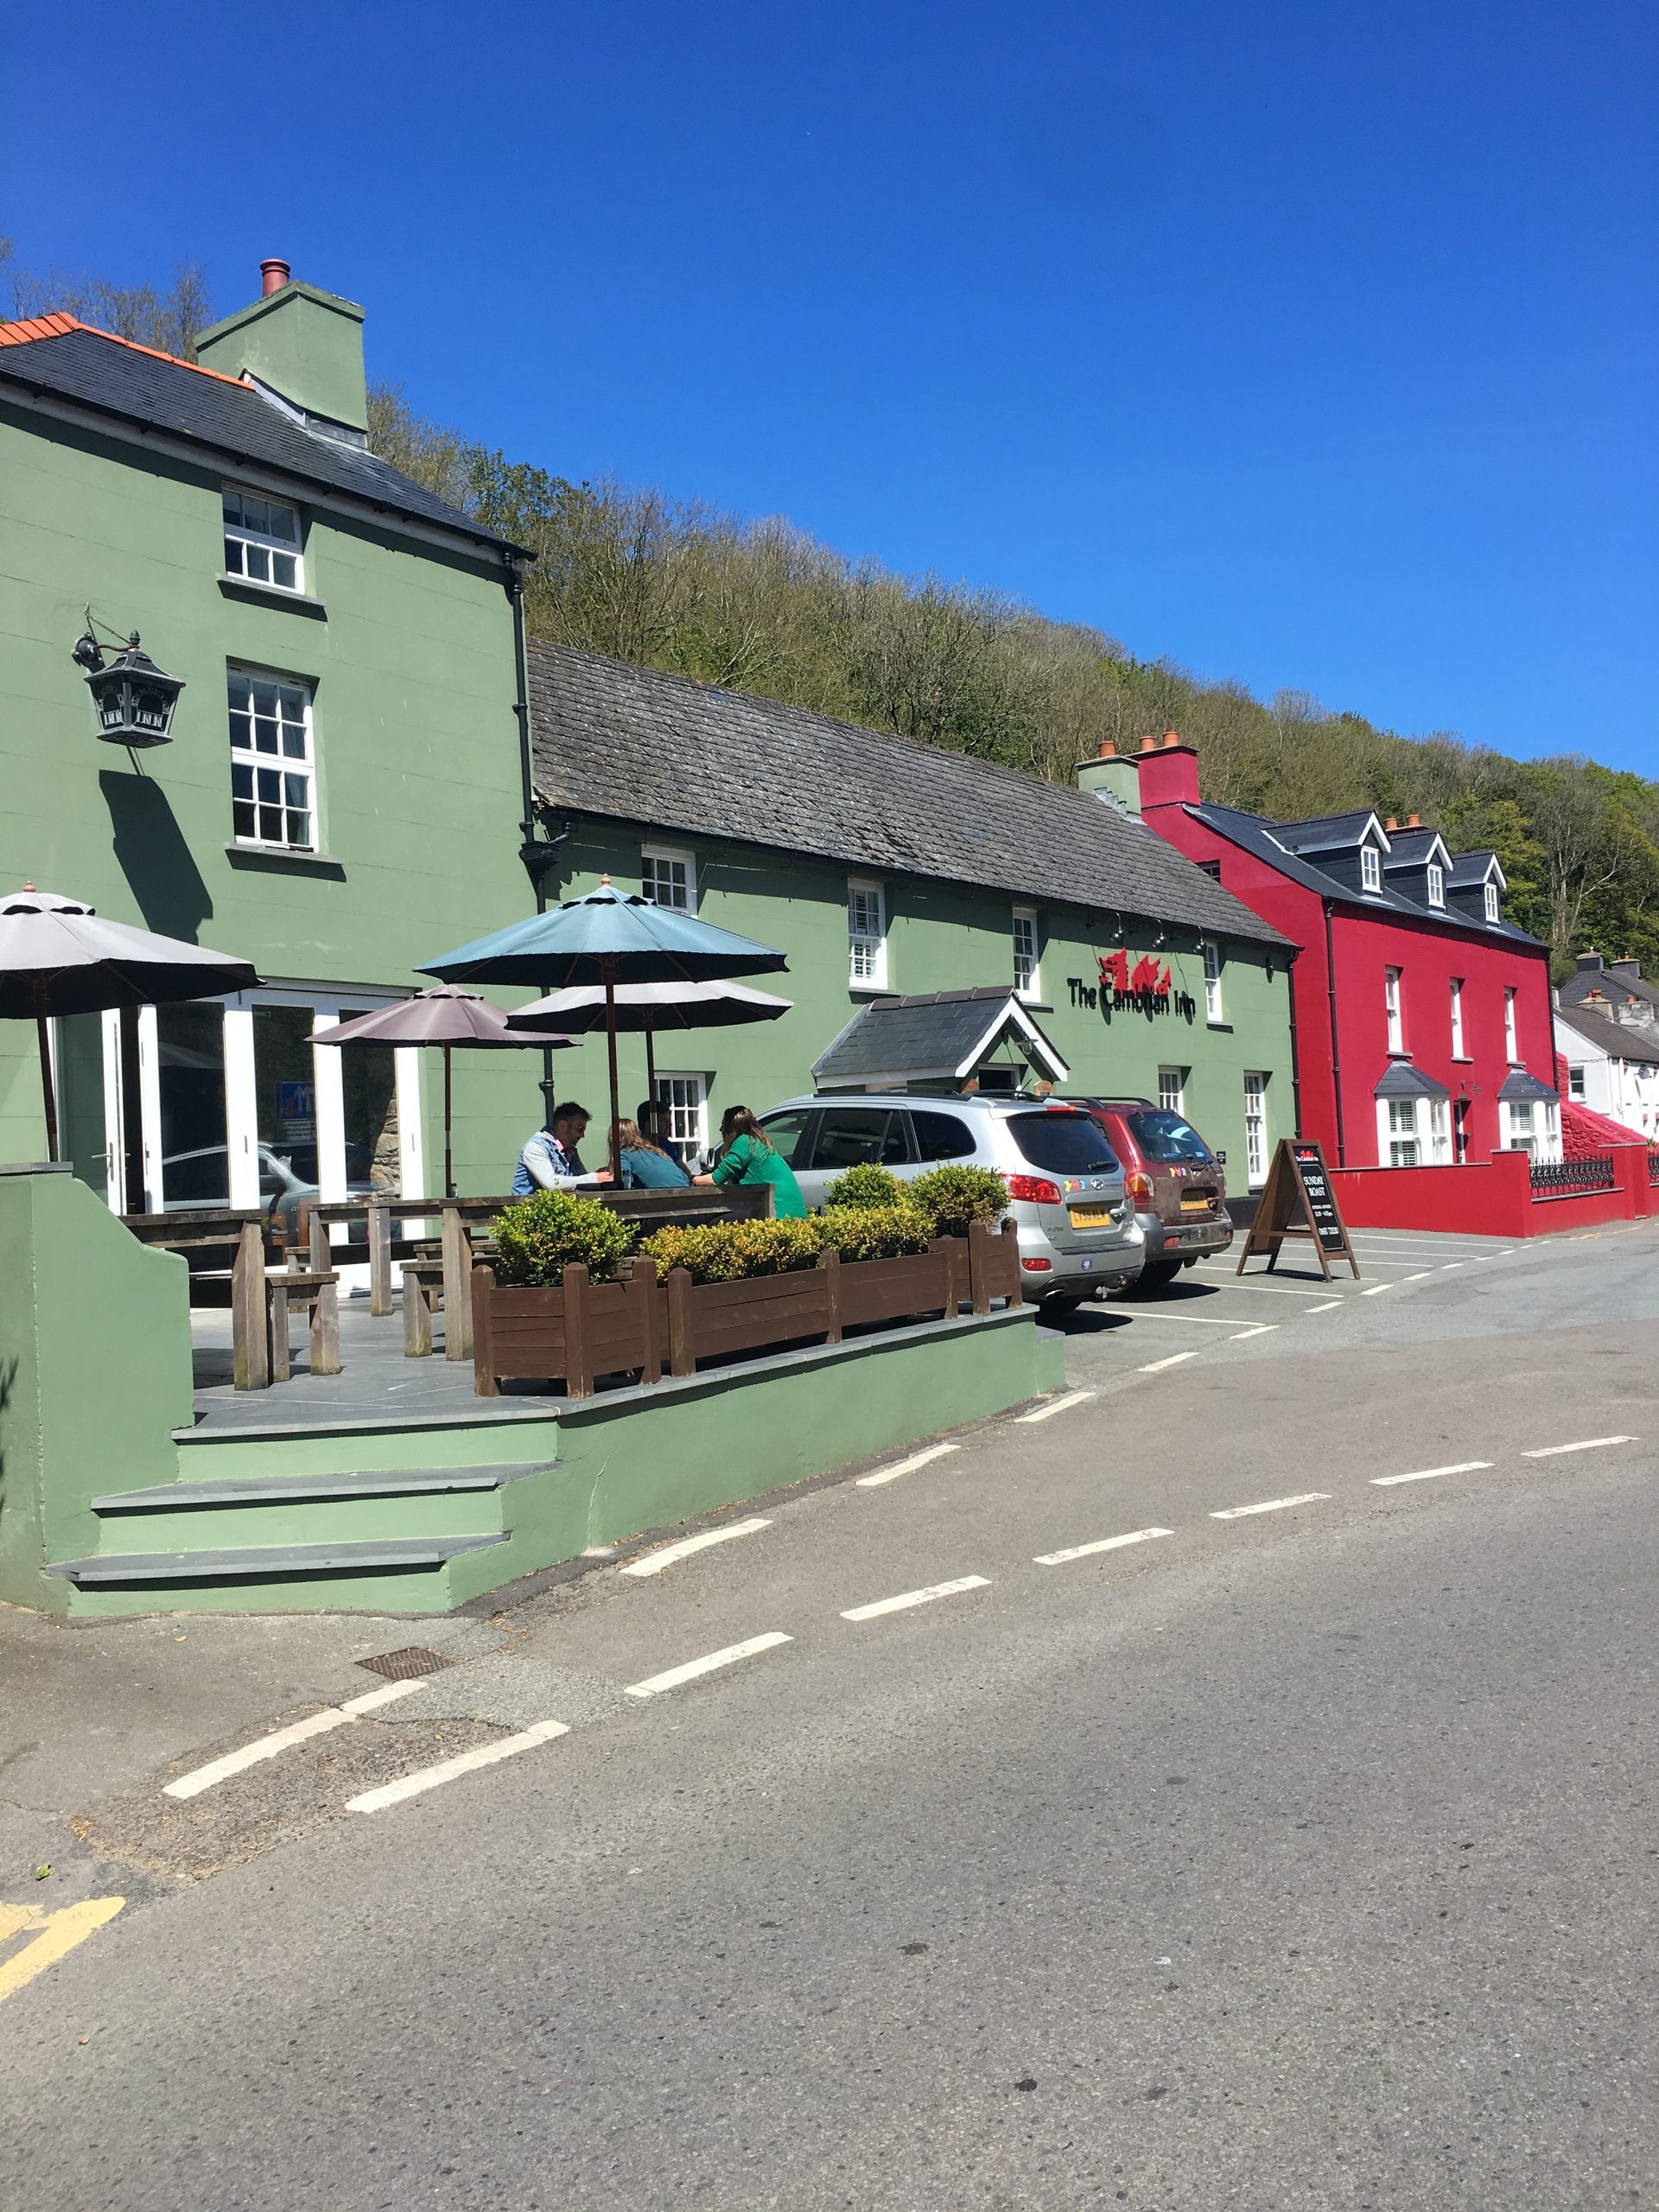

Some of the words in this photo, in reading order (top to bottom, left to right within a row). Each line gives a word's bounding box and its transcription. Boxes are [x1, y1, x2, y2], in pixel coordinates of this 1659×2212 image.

[104, 710, 122, 726] INN
[137, 711, 162, 728] INN
[1067, 978, 1096, 1009] The
[1100, 982, 1170, 1015] Cambrian
[1173, 990, 1196, 1017] Inn
[1303, 1176, 1324, 1185] SUNDAY
[1308, 1187, 1325, 1197] ROAST
